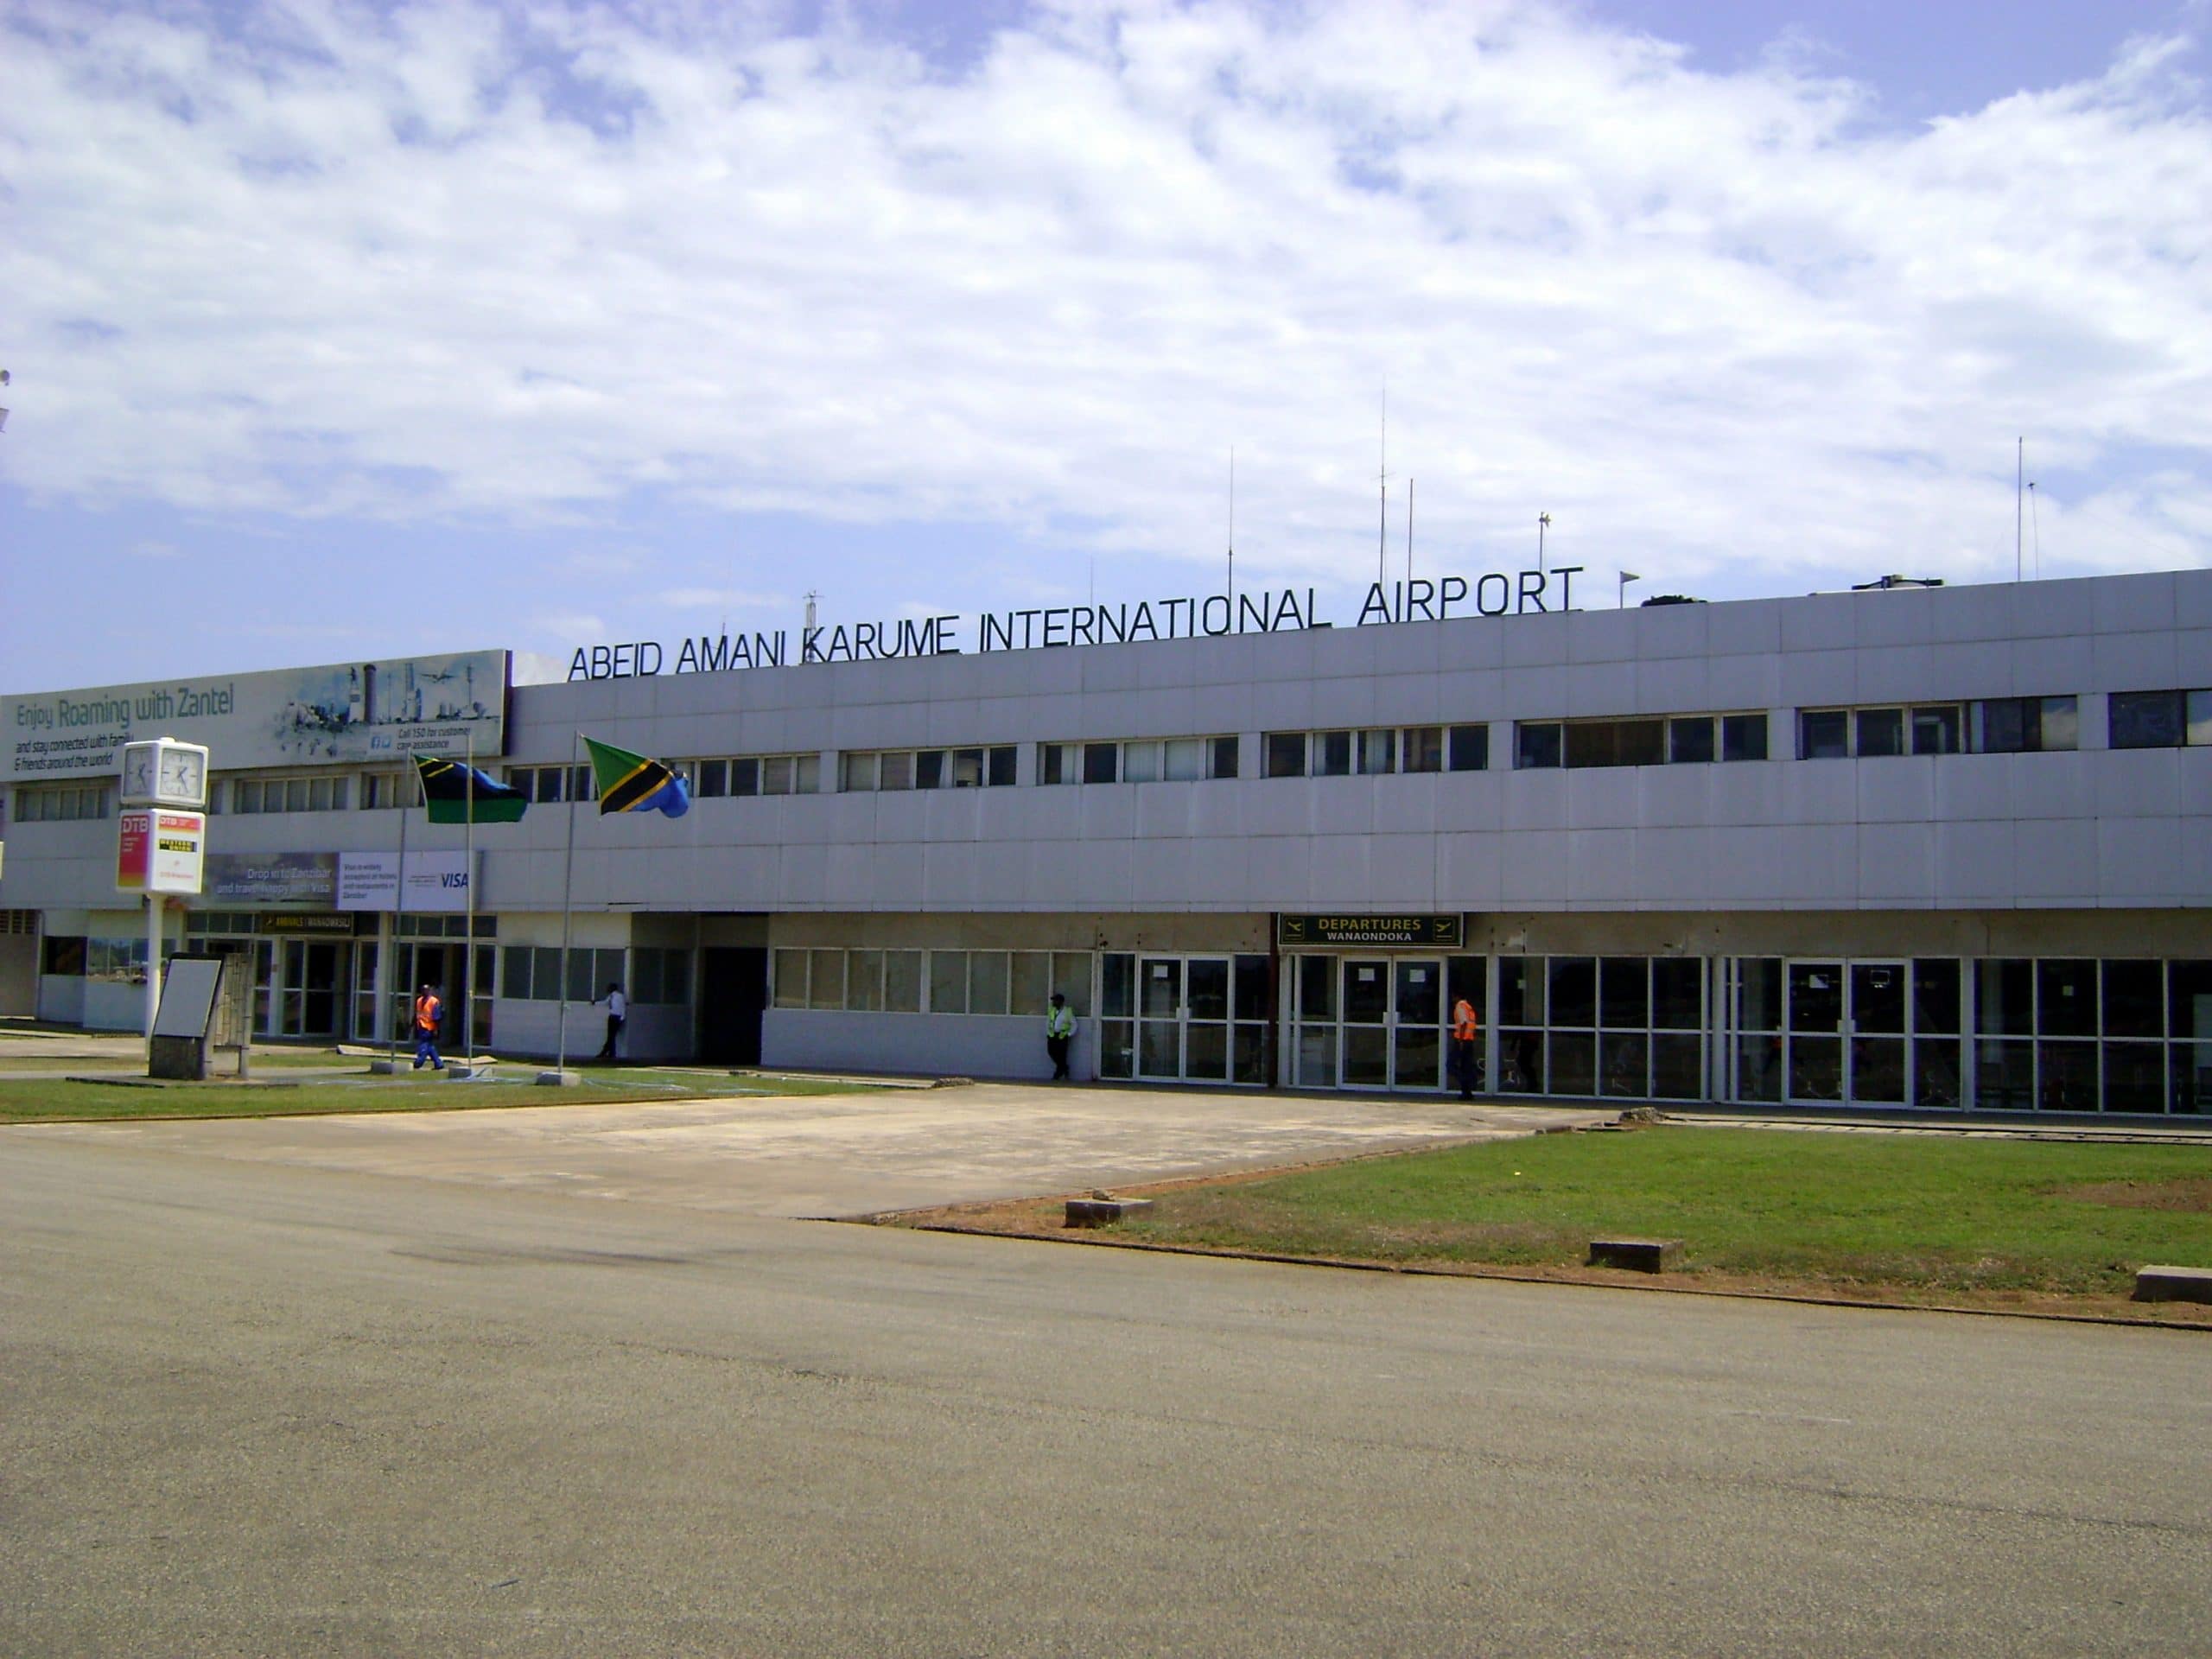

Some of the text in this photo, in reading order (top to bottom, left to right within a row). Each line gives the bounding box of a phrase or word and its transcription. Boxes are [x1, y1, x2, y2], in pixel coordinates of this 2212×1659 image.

[567, 567, 1583, 682] ABEID AMANI KARUME INTERNATIONAL AIRPORT
[17, 683, 234, 730] Enjoy Roaming with Zantel
[413, 727, 426, 738] 150
[16, 741, 31, 753] and
[32, 741, 48, 754] stay
[49, 734, 89, 753] connected
[90, 734, 107, 749] with
[22, 755, 47, 770] friends
[47, 754, 73, 769] around
[74, 754, 88, 767] the
[89, 752, 113, 766] world
[123, 817, 149, 833] DTB
[160, 817, 178, 826] DTB
[248, 868, 270, 880] Drop
[290, 868, 332, 879] Zanzibar
[442, 873, 468, 888] VISA
[217, 883, 233, 893] and
[1319, 918, 1421, 931] DEPARTURES
[1327, 932, 1412, 941] WANAONDOKA
